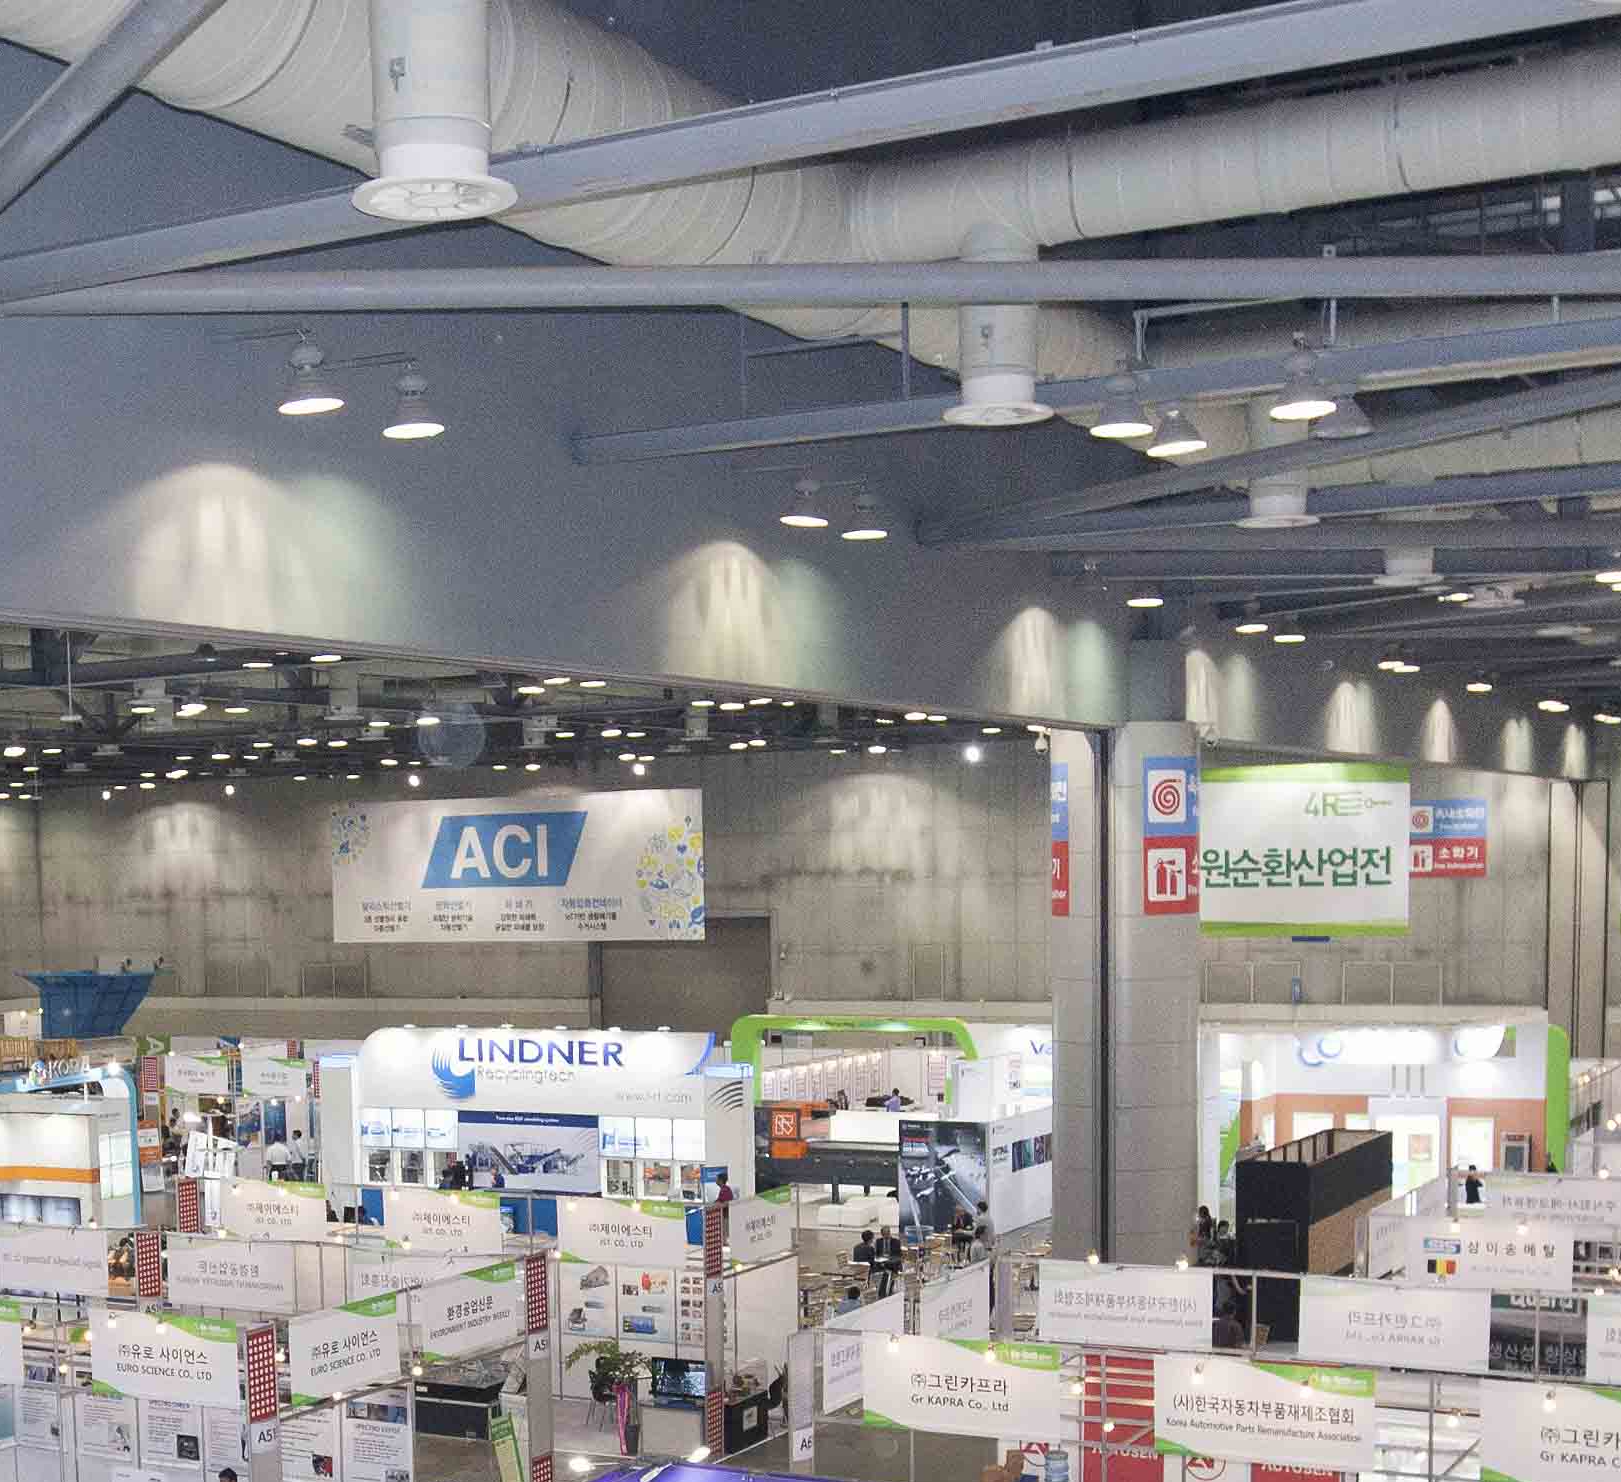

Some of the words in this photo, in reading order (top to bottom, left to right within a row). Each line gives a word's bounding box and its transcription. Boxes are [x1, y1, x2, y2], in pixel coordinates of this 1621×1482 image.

[450, 824, 549, 879] ACI
[1200, 846, 1393, 889] 원순환산업전
[458, 1038, 624, 1066] LINDNER
[446, 1295, 493, 1318] 환경공업신문
[342, 1329, 378, 1354] 사이언스
[117, 1343, 156, 1363] (주)유로
[159, 1346, 209, 1365] 사이언스
[116, 1362, 138, 1376] EURO
[140, 1364, 173, 1379] SCIENCE
[196, 1369, 213, 1381] LTD
[310, 1363, 328, 1378] EURO
[329, 1356, 358, 1374] SCIENCE
[910, 1372, 1009, 1398] (주)그린카프라
[926, 1397, 963, 1410] KAPRA
[989, 1400, 1010, 1413] Ltd
[1172, 1392, 1356, 1426] (사)한국자동차부품재제조협회
[1189, 1417, 1234, 1432] Automotive
[1235, 1421, 1255, 1434] Parts
[1540, 1449, 1557, 1464] Gr
[1560, 1451, 1607, 1467] KAPRA
